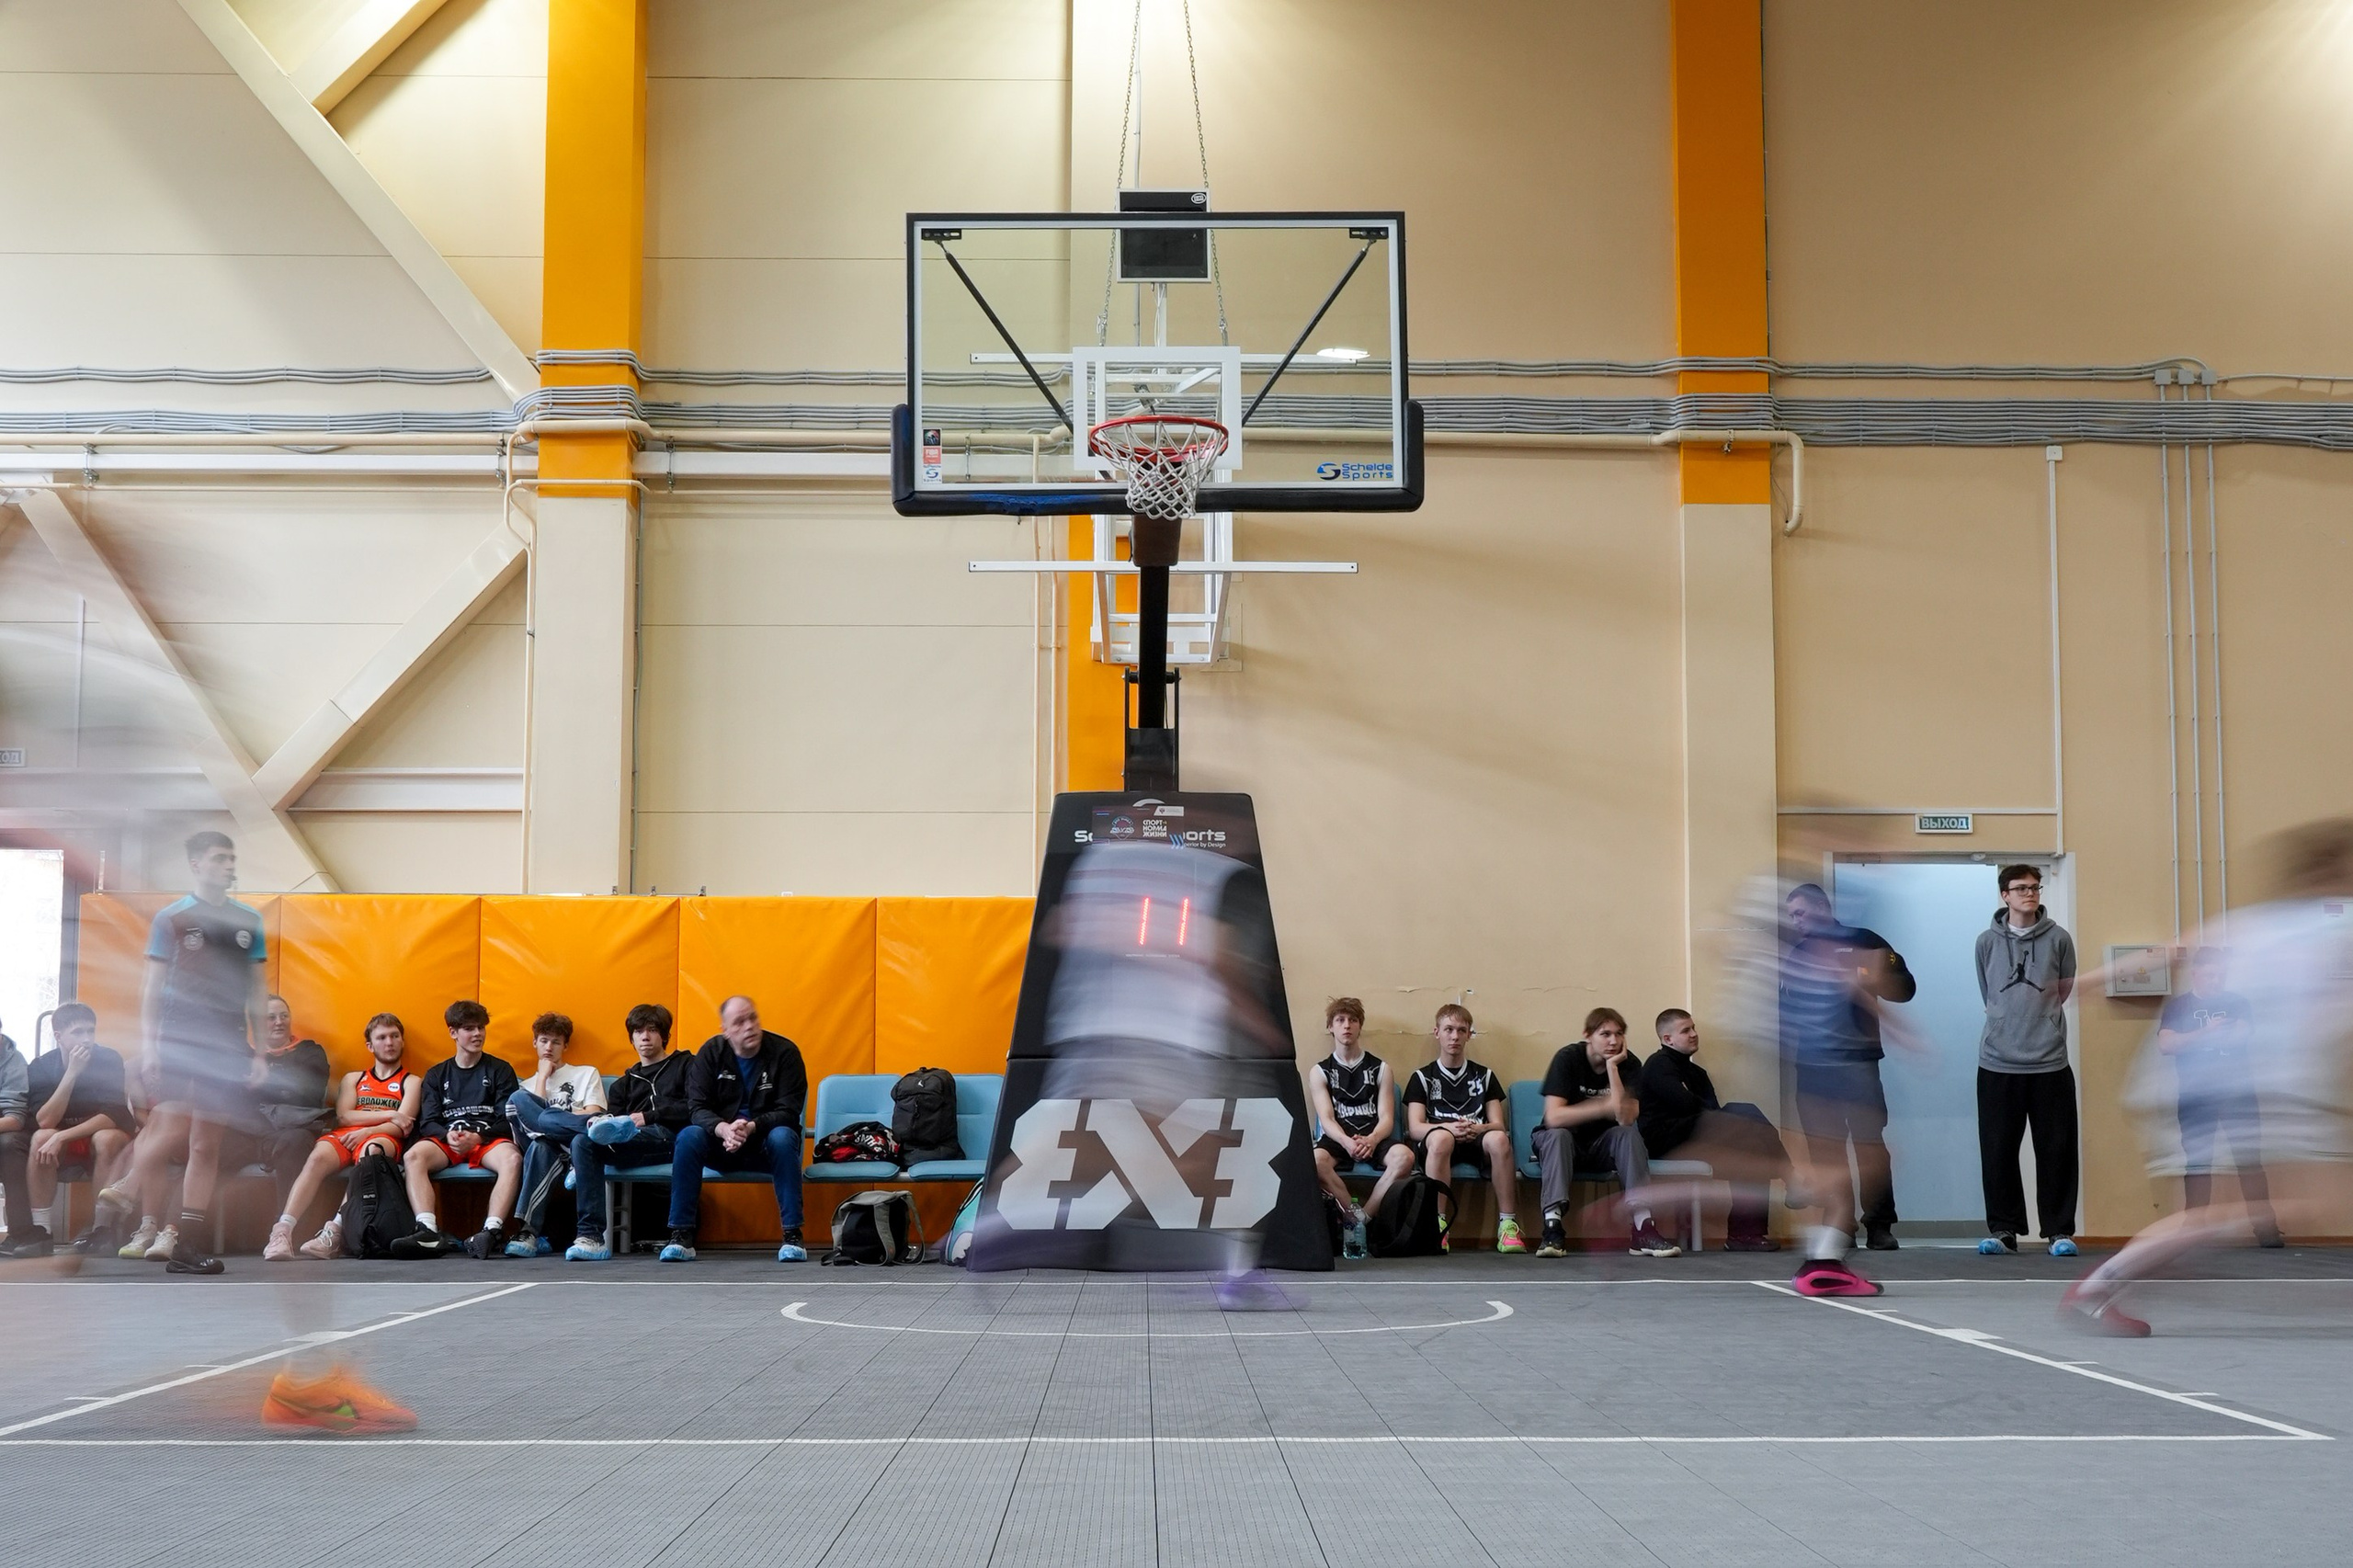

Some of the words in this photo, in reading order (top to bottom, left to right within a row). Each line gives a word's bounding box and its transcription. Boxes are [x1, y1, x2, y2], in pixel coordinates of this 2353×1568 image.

[1342, 471, 1392, 481] Sports
[0, 752, 19, 764] ОД
[1921, 818, 1967, 829] ВЫХОД
[1467, 1077, 1483, 1096] 25
